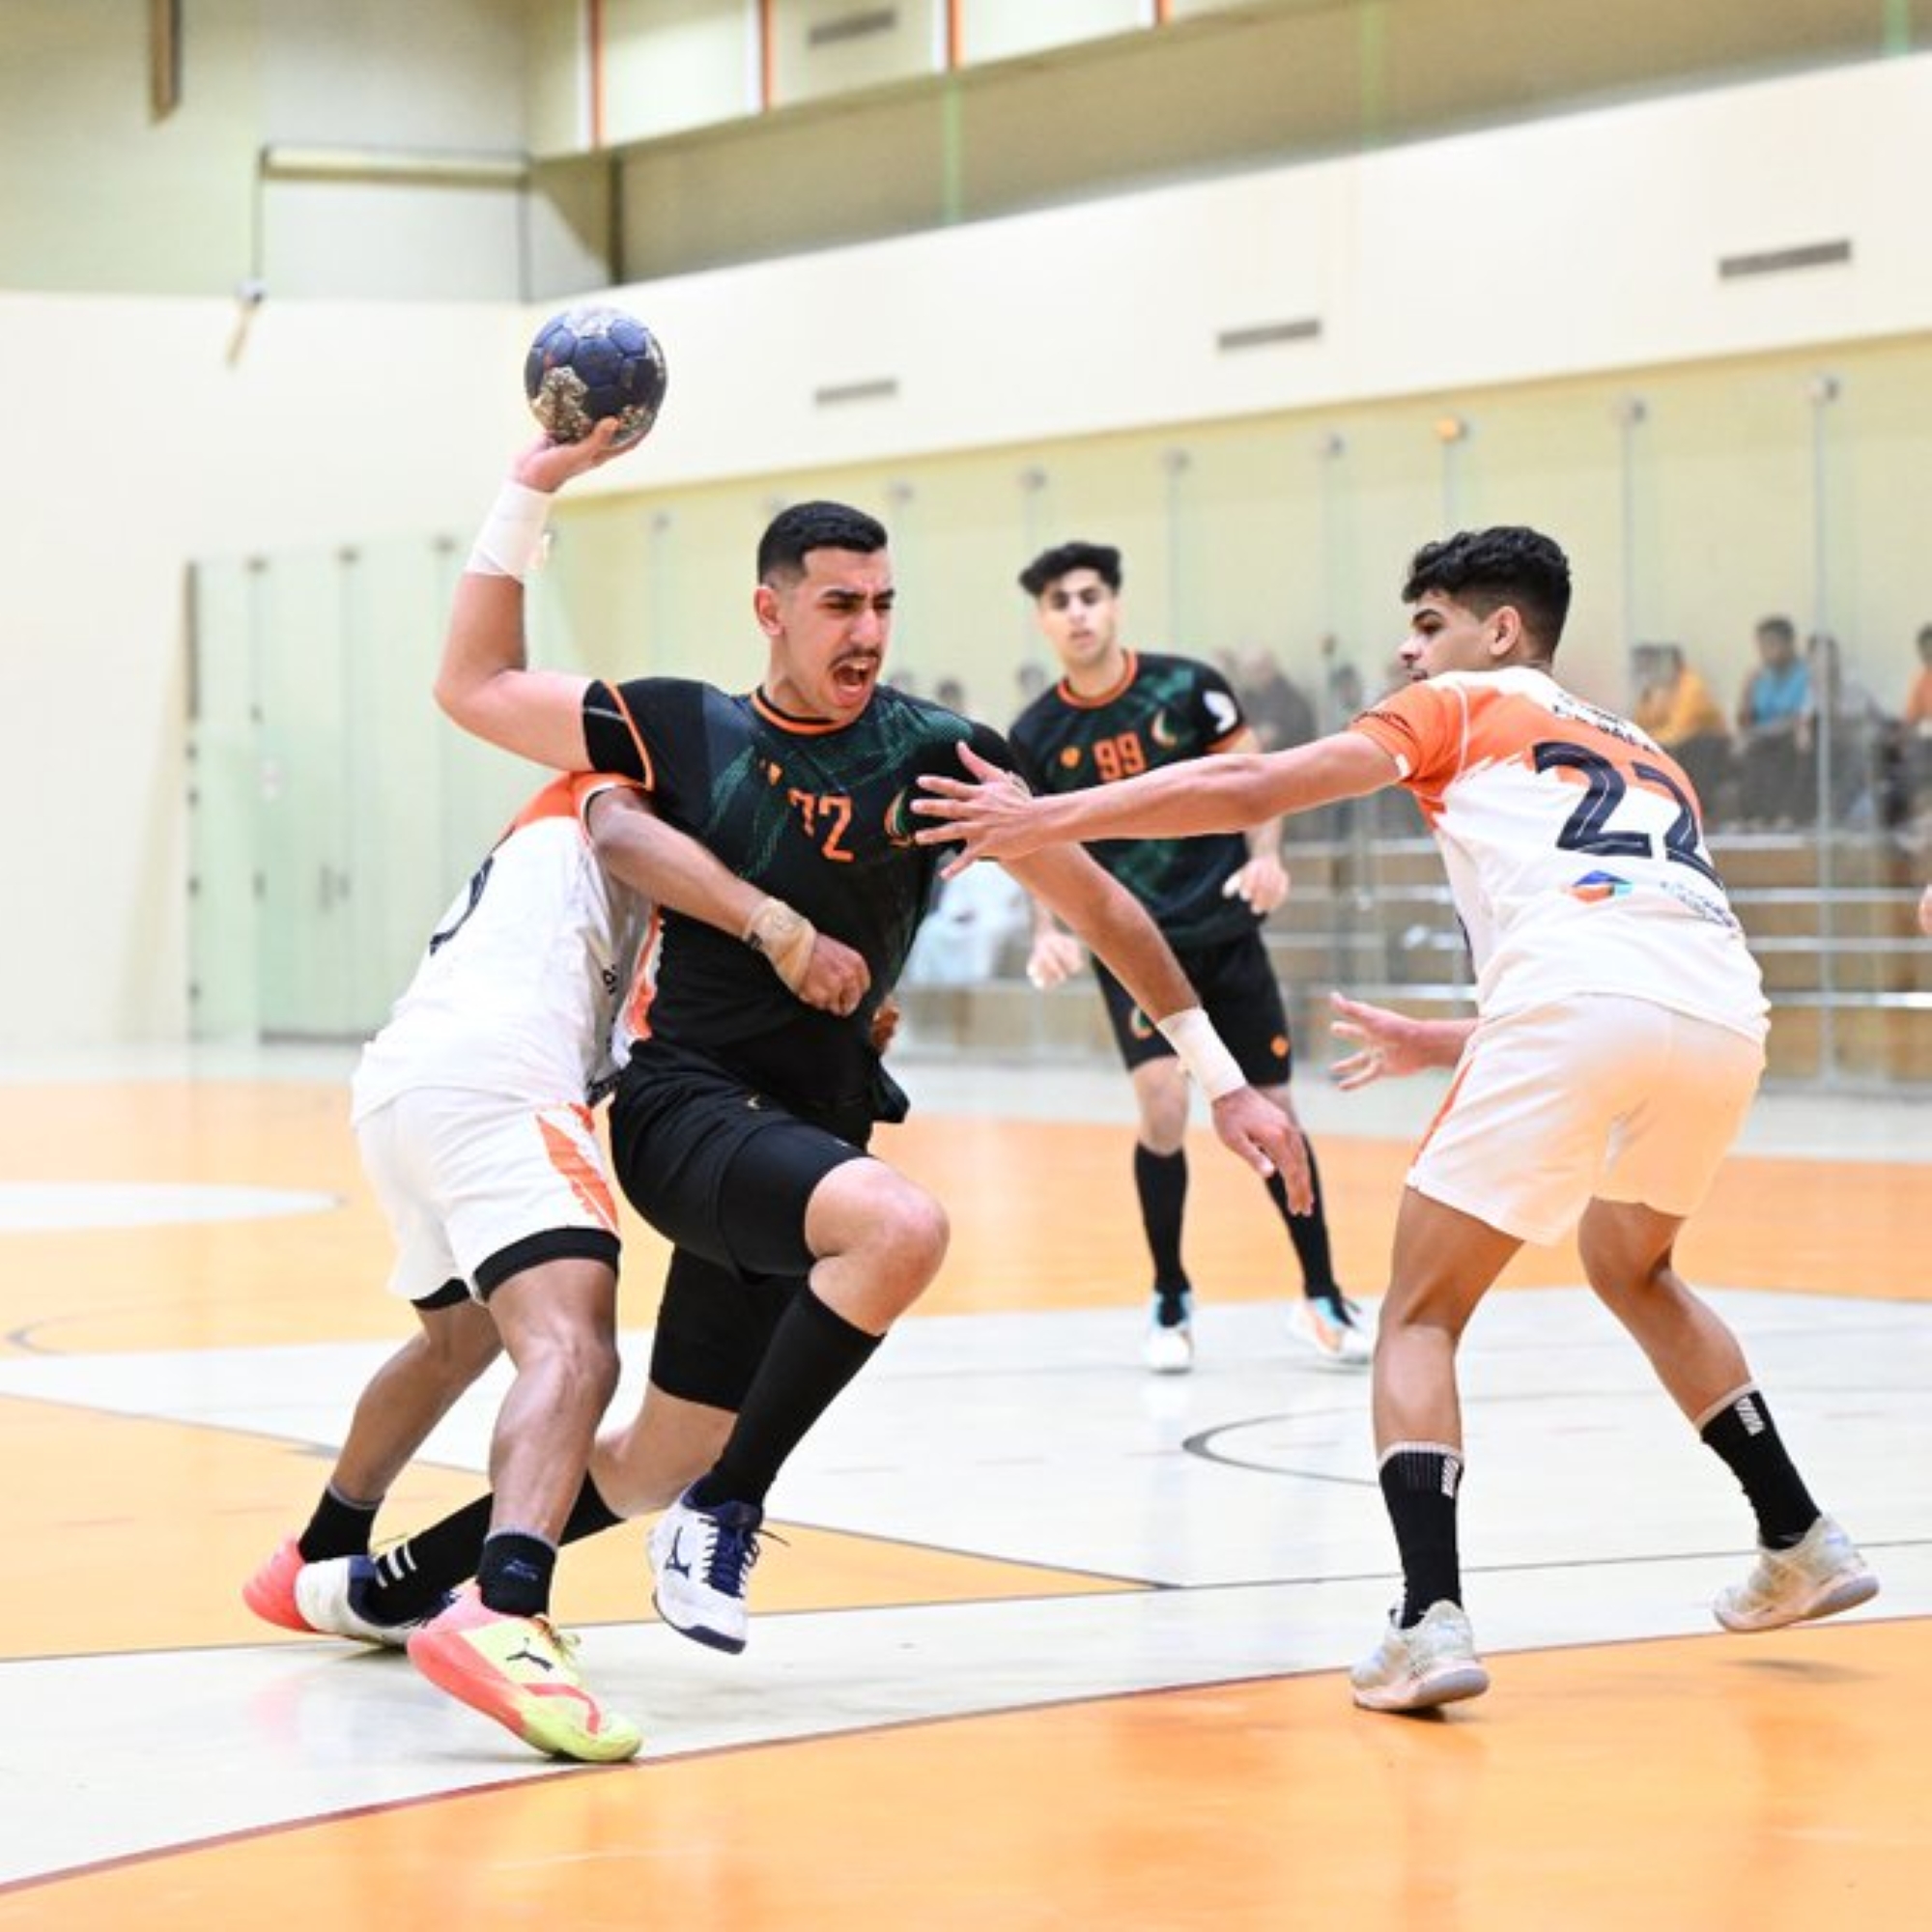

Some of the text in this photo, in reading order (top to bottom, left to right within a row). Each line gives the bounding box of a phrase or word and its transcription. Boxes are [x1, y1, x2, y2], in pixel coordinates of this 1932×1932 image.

[1094, 731, 1147, 782] 99
[787, 786, 854, 863] 72
[1533, 741, 1724, 891] 22
